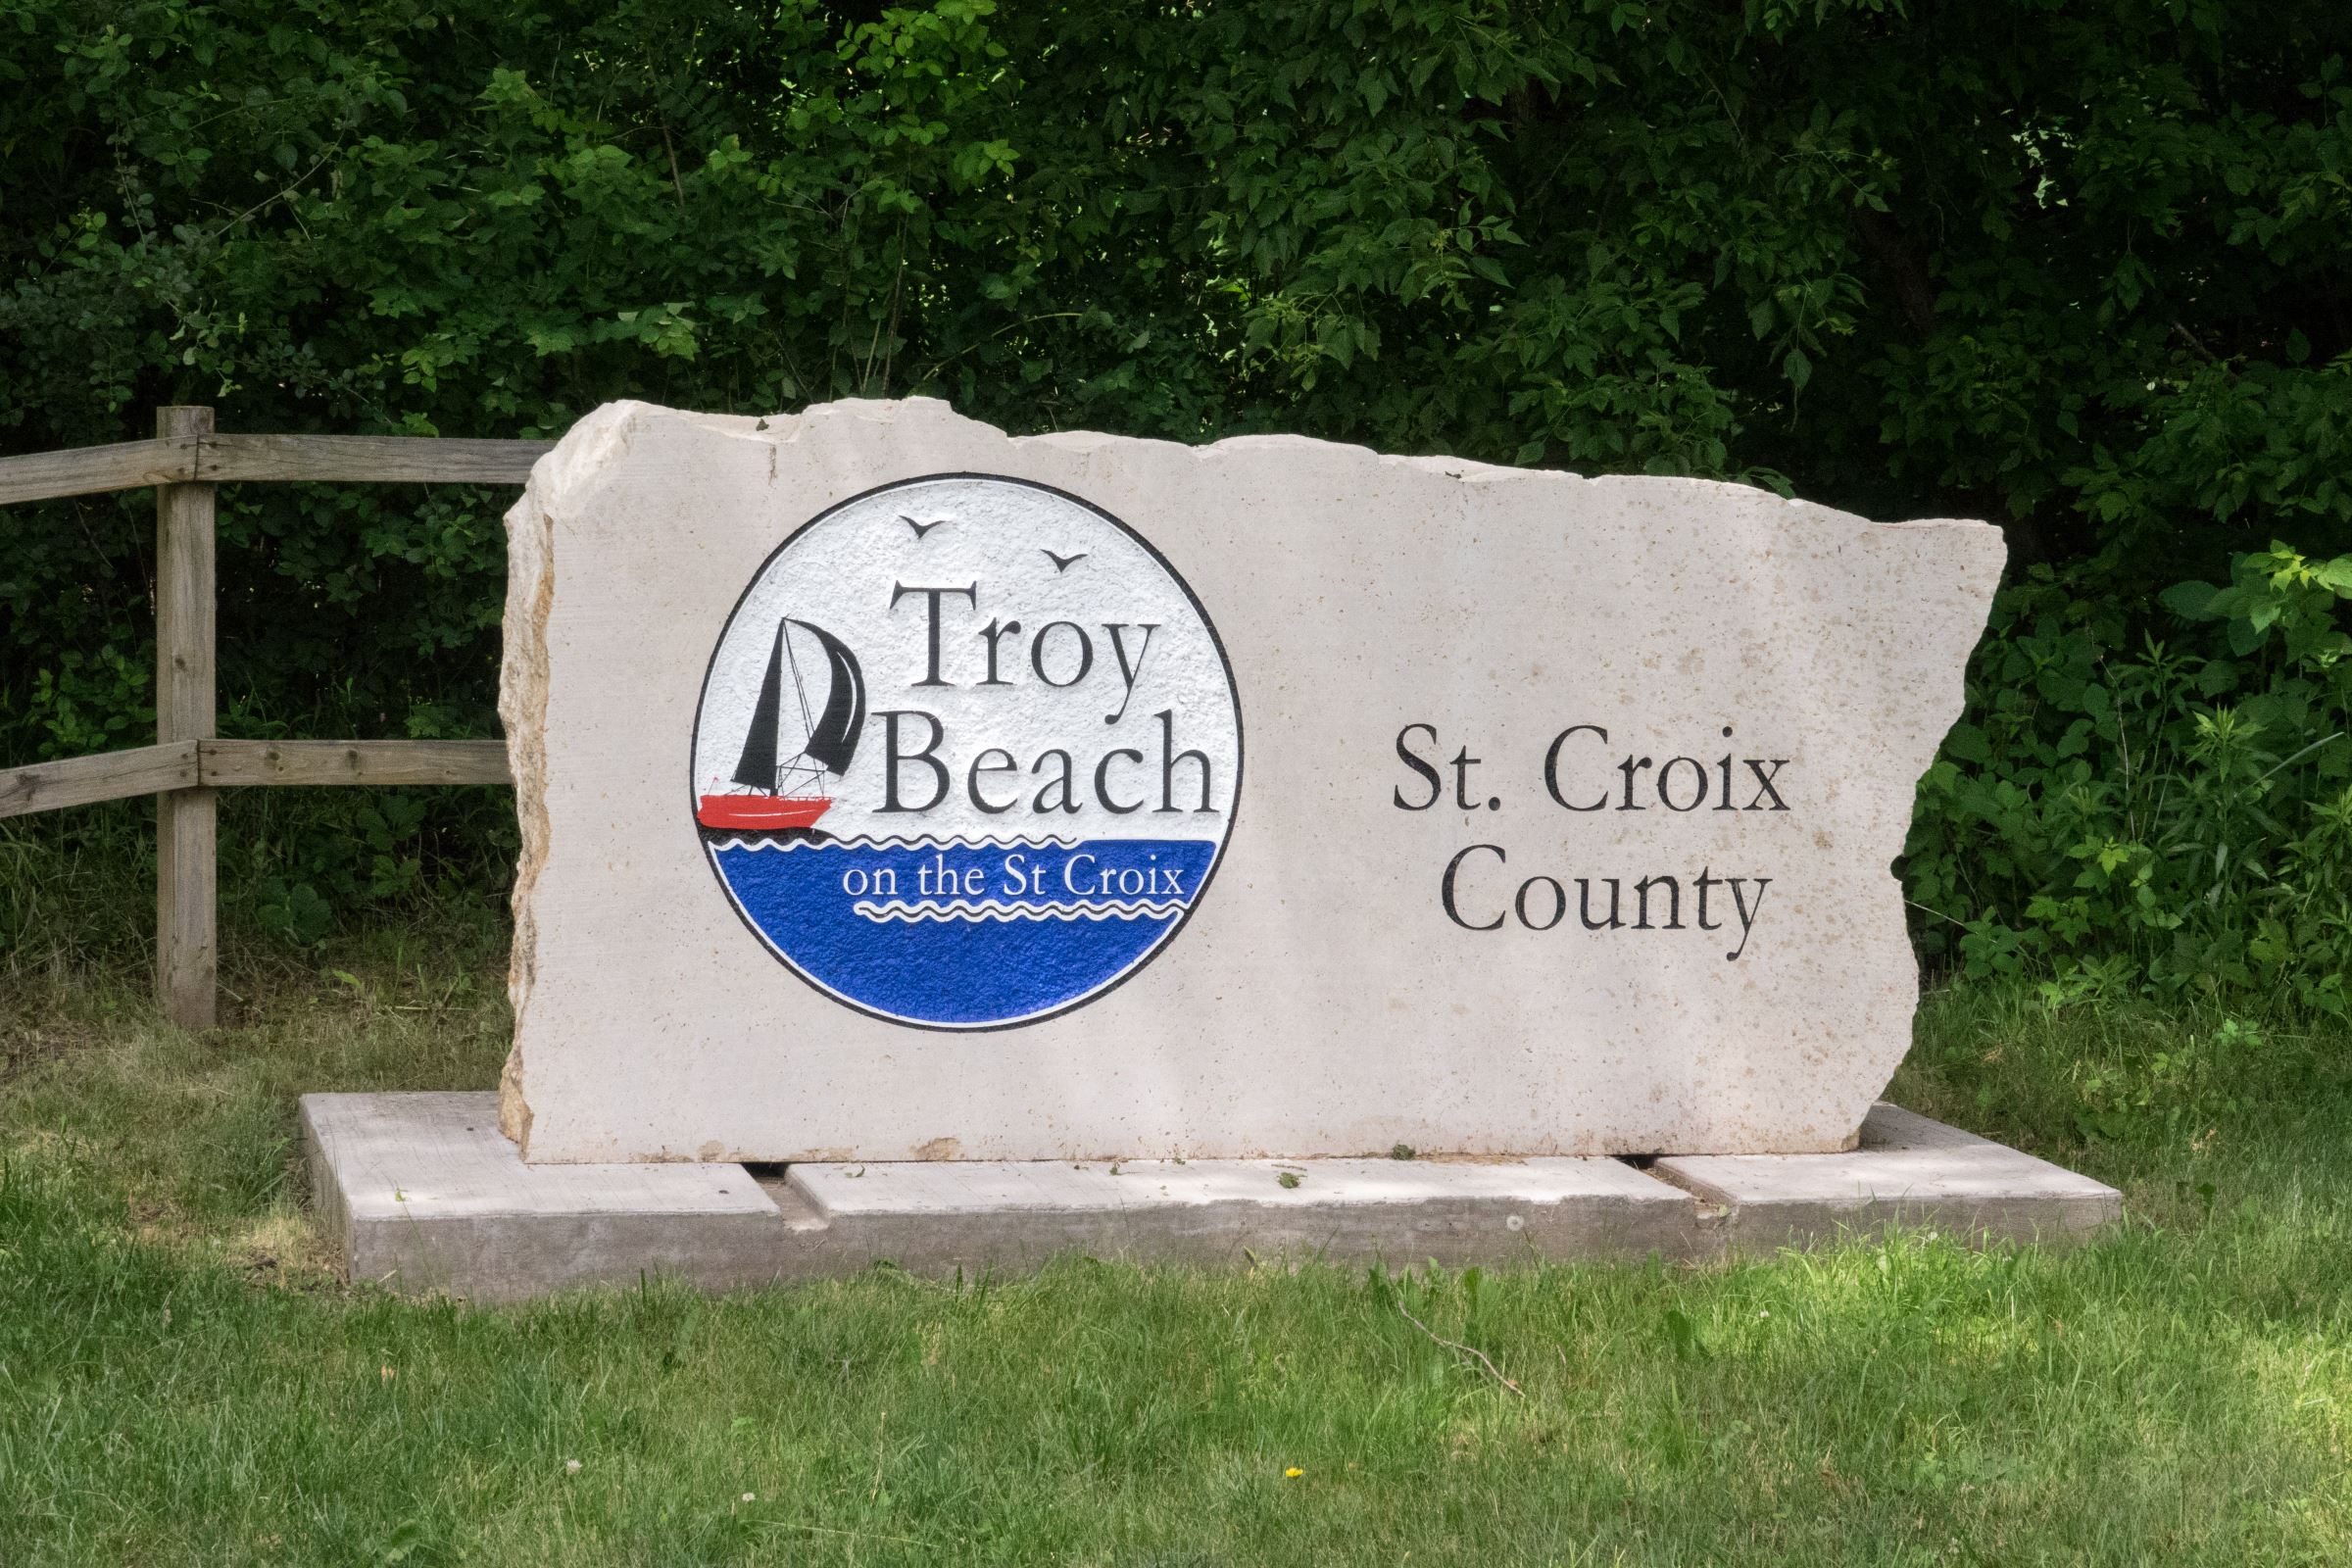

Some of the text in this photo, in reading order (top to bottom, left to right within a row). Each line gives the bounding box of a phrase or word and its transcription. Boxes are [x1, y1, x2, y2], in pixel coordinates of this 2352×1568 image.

[889, 579, 1161, 726] Troy
[871, 709, 1220, 814] Beach
[1393, 722, 1791, 812] St. Croix
[842, 854, 1185, 897] on the St Croix
[1441, 844, 1774, 961] County
